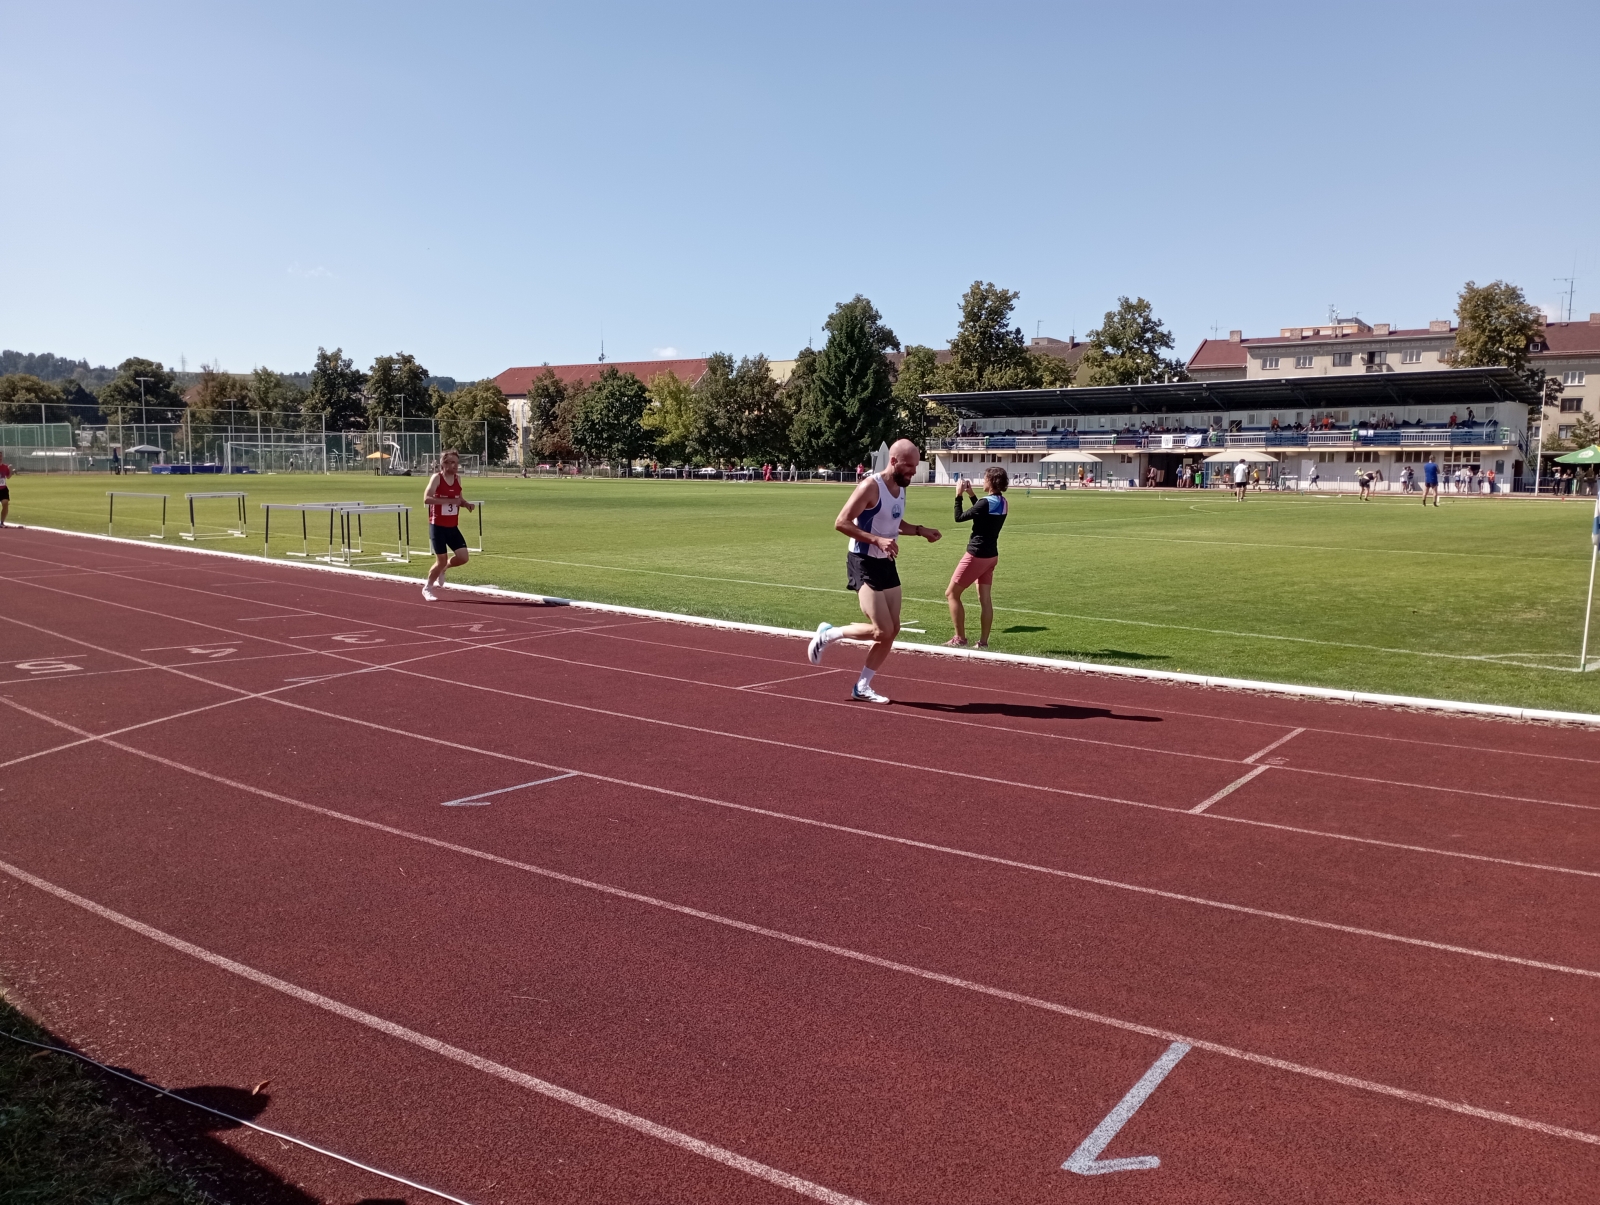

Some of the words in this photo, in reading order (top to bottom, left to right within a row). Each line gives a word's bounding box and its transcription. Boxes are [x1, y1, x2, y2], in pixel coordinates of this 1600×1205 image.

[448, 504, 453, 512] 3
[331, 634, 386, 644] 3
[185, 647, 238, 658] 4
[14, 660, 84, 675] 5
